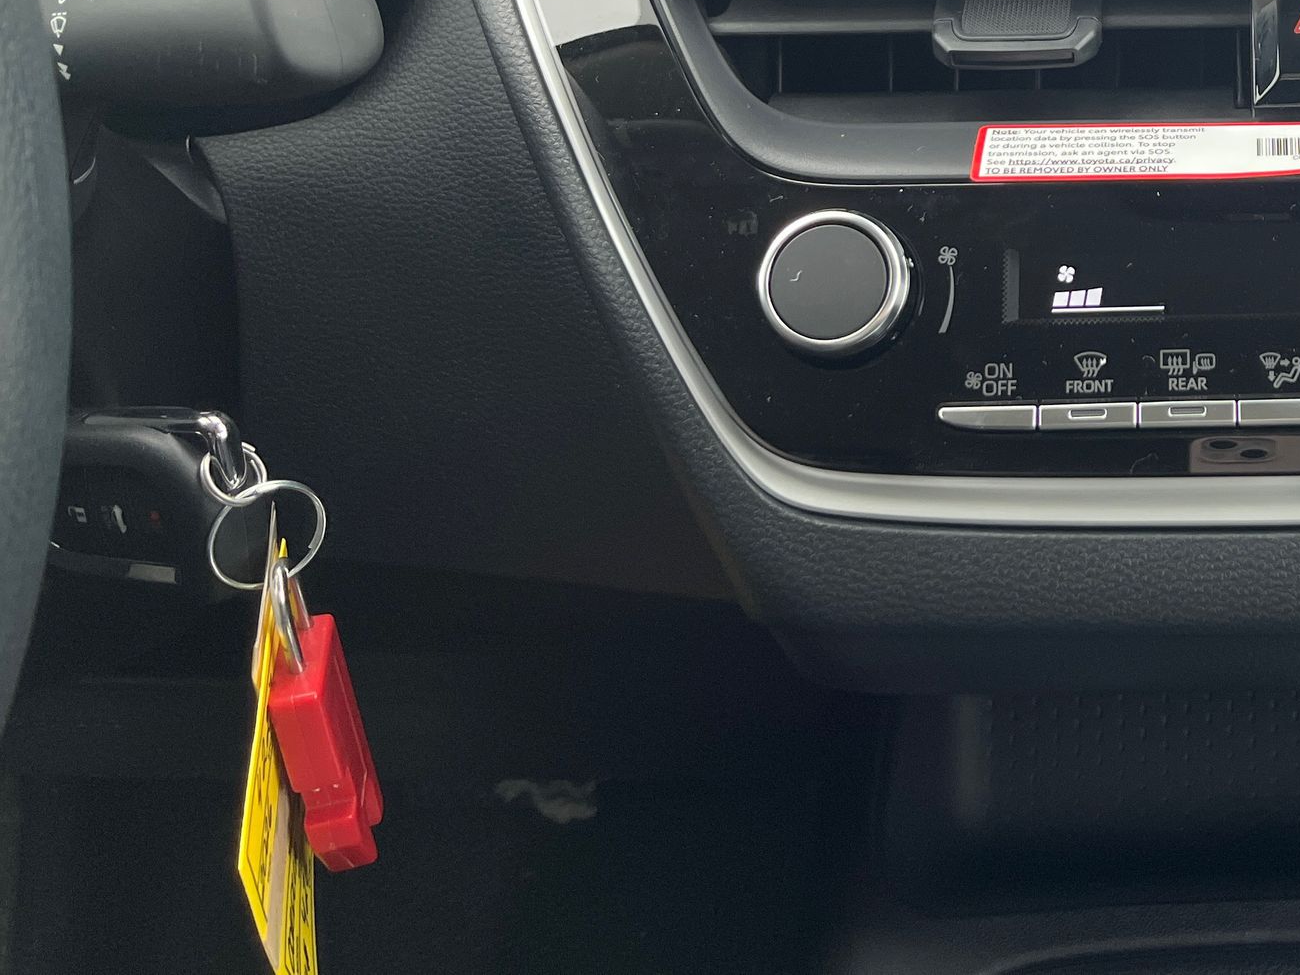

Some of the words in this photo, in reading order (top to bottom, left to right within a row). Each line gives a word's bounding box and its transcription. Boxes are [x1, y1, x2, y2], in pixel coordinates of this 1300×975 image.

[1019, 166, 1074, 174] REMOVED
[984, 362, 1013, 380] ON
[982, 380, 1018, 396] OFF
[1065, 379, 1114, 394] FRONT
[1168, 377, 1209, 391] REAR
